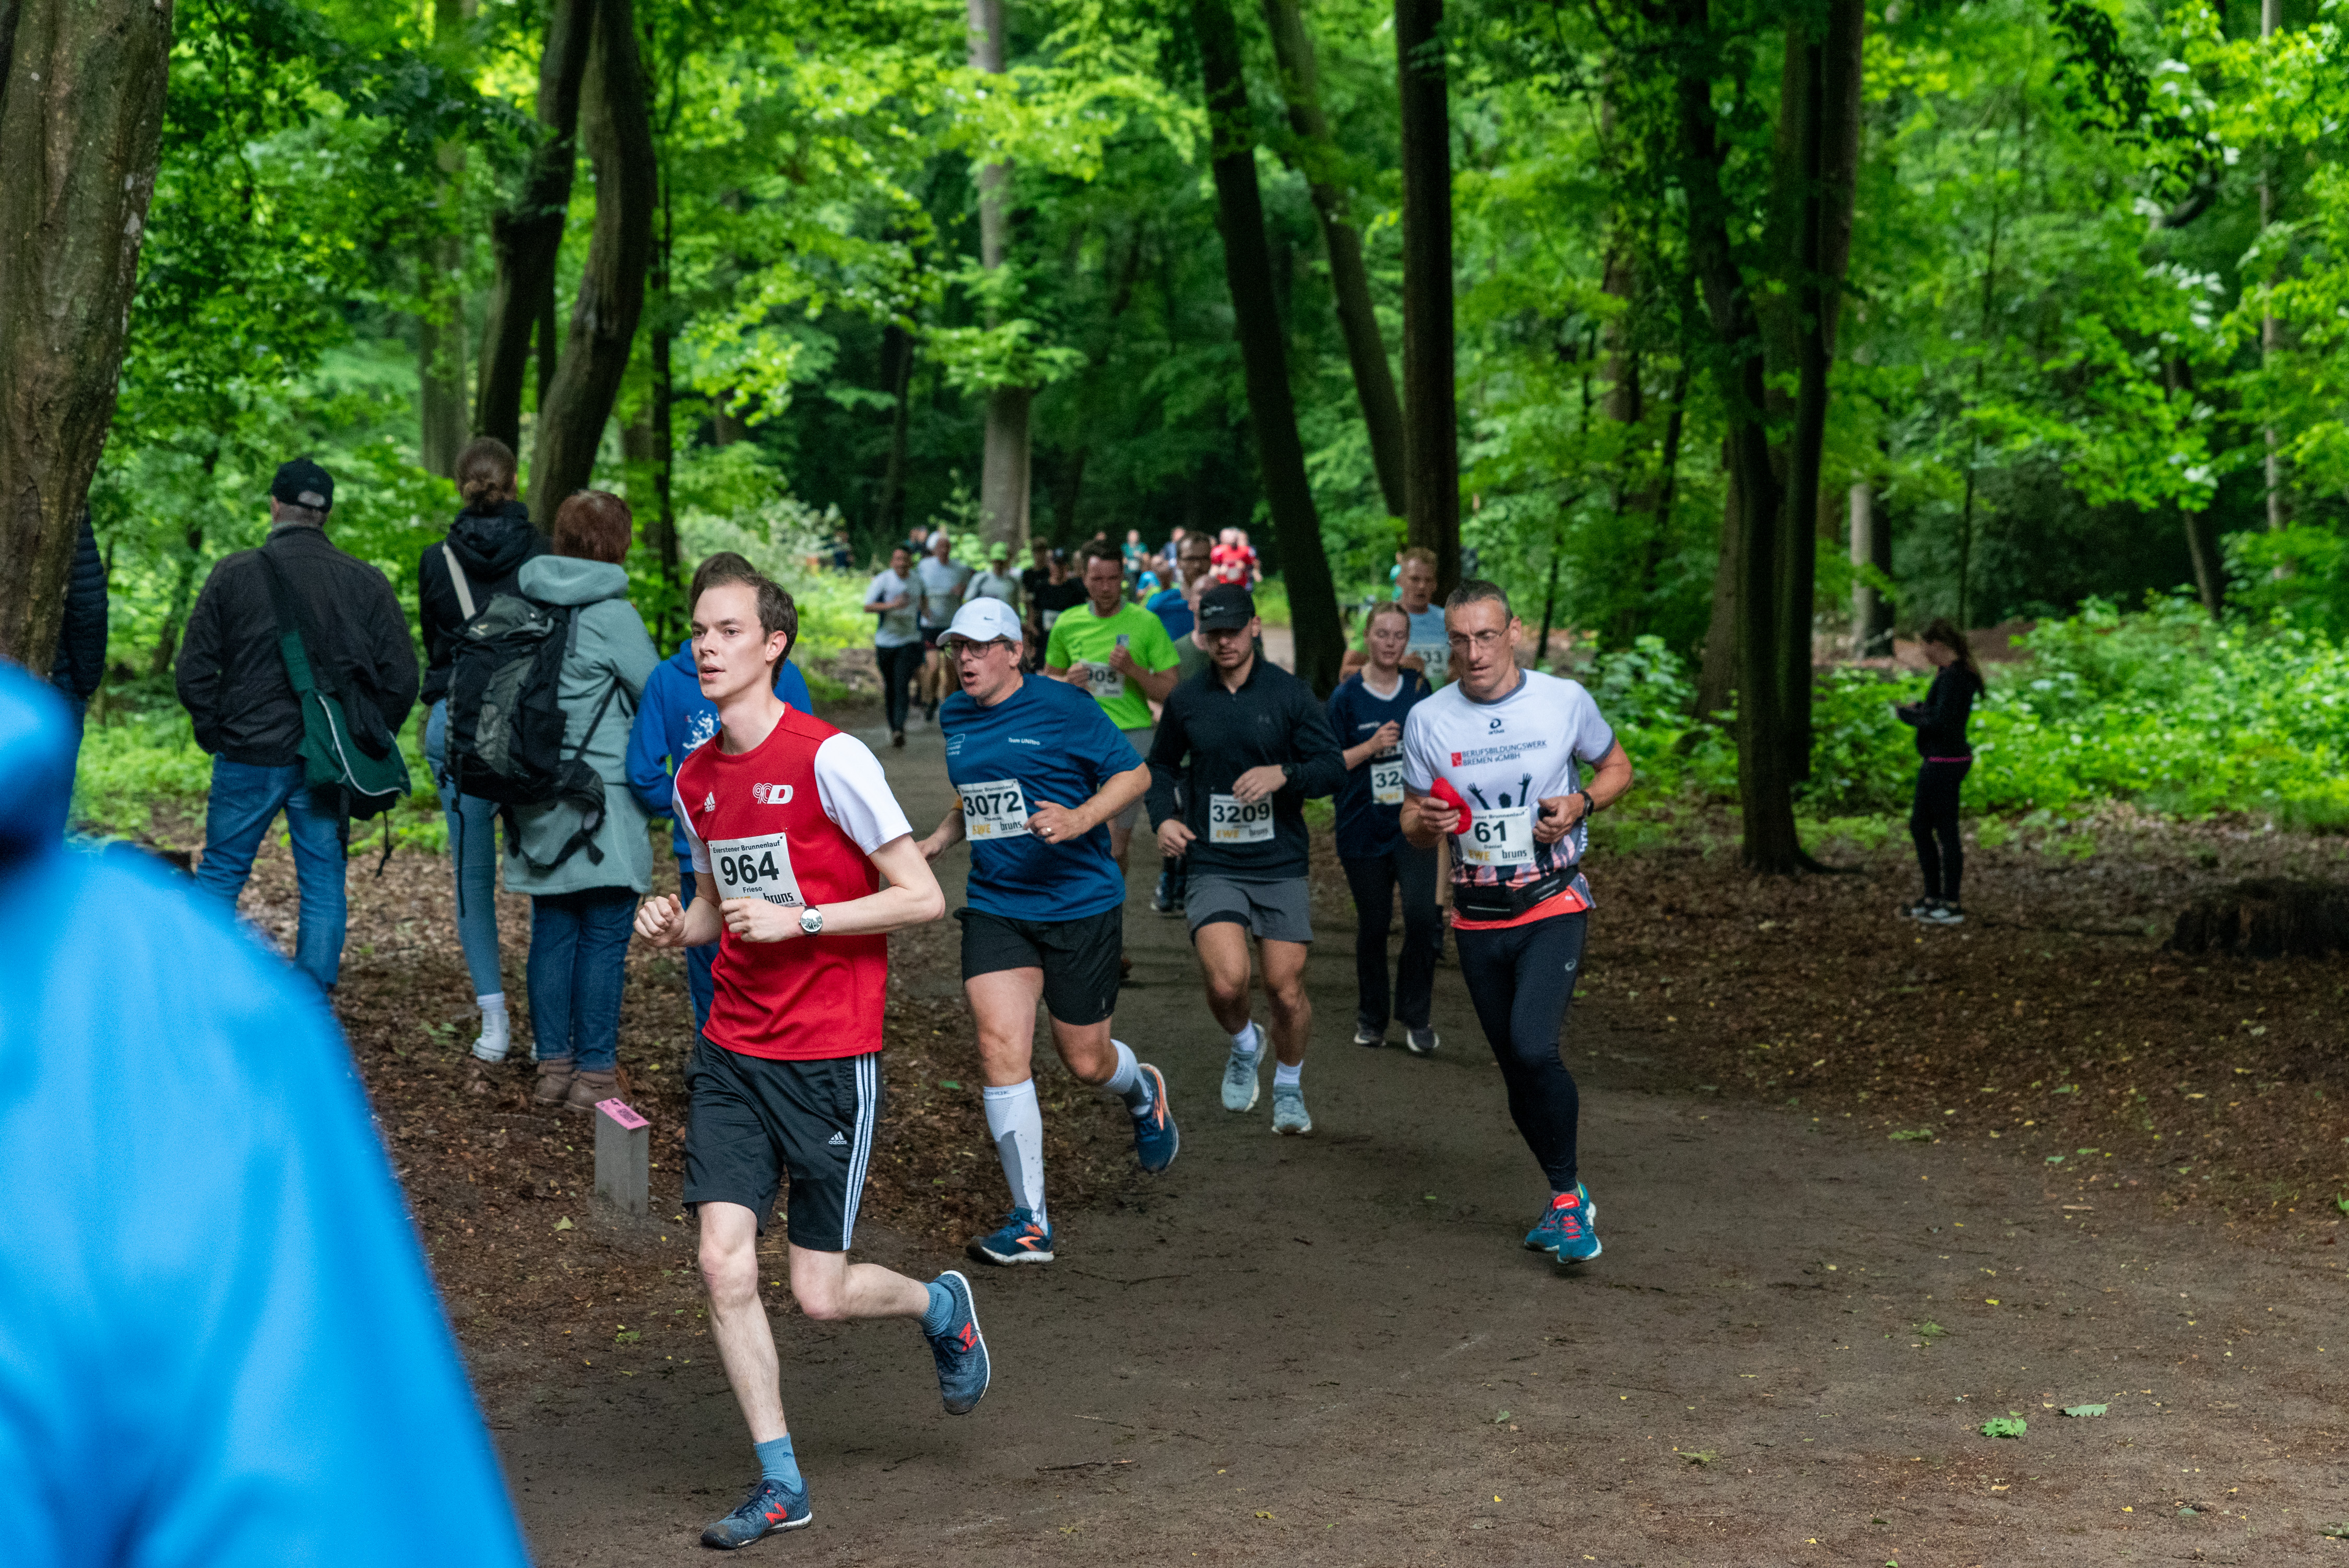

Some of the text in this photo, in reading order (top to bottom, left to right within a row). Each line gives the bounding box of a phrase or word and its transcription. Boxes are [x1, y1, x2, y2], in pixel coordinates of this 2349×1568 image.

[1462, 740, 1547, 757] BERUFSBILDUNGSWERK
[1463, 757, 1493, 766] BREMEN
[963, 791, 1023, 817] 3072
[1213, 803, 1270, 823] 3209
[1000, 821, 1023, 831] bruns
[1474, 820, 1506, 843] 61
[741, 840, 780, 851] Brunnenlauf
[1468, 849, 1490, 861] EWE
[1502, 849, 1527, 859] bruns
[720, 851, 780, 886] 964
[763, 892, 794, 904] bruns
